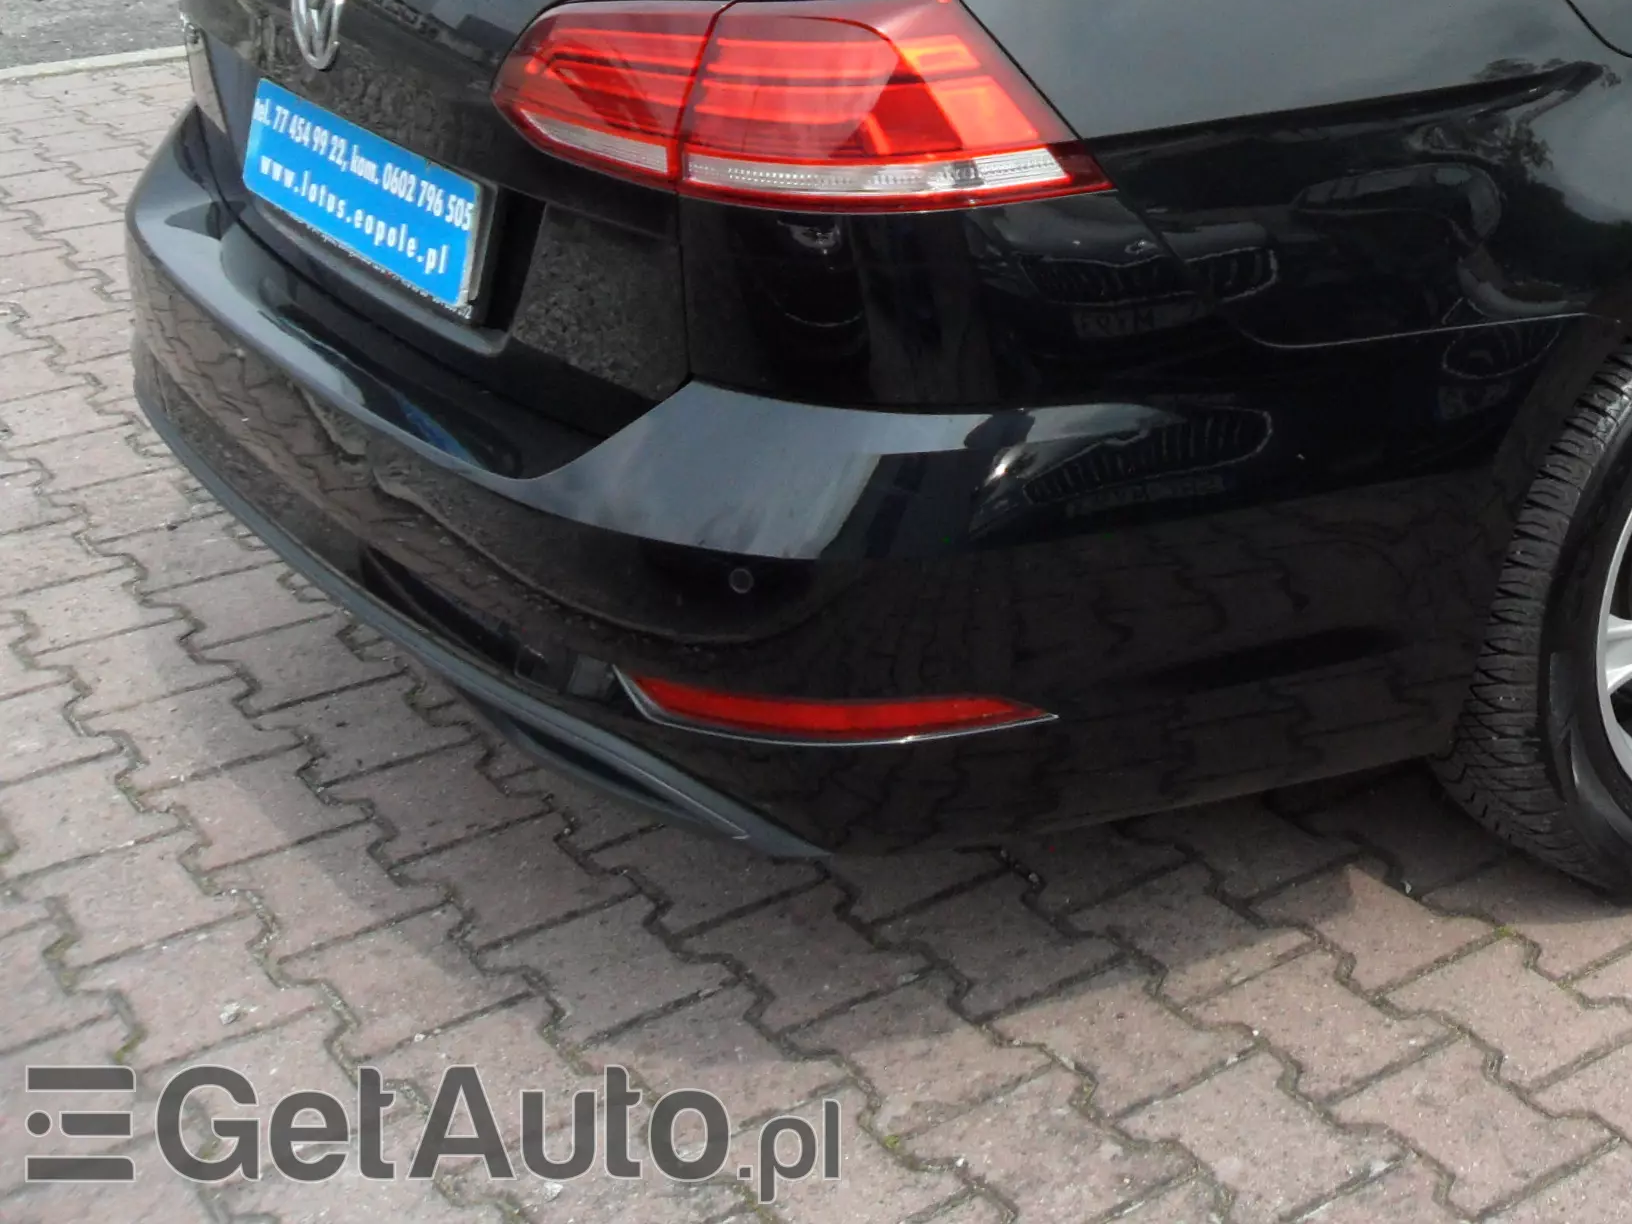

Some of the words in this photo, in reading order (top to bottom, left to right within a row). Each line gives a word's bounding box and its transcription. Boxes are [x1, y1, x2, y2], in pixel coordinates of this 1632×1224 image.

[260, 155, 448, 275] www.lotus.eopole.pl
[272, 105, 290, 133] 77
[289, 114, 312, 147] 454
[312, 125, 329, 156] 99
[382, 162, 418, 203] 0602
[417, 180, 445, 217] 796
[445, 194, 474, 231] 505
